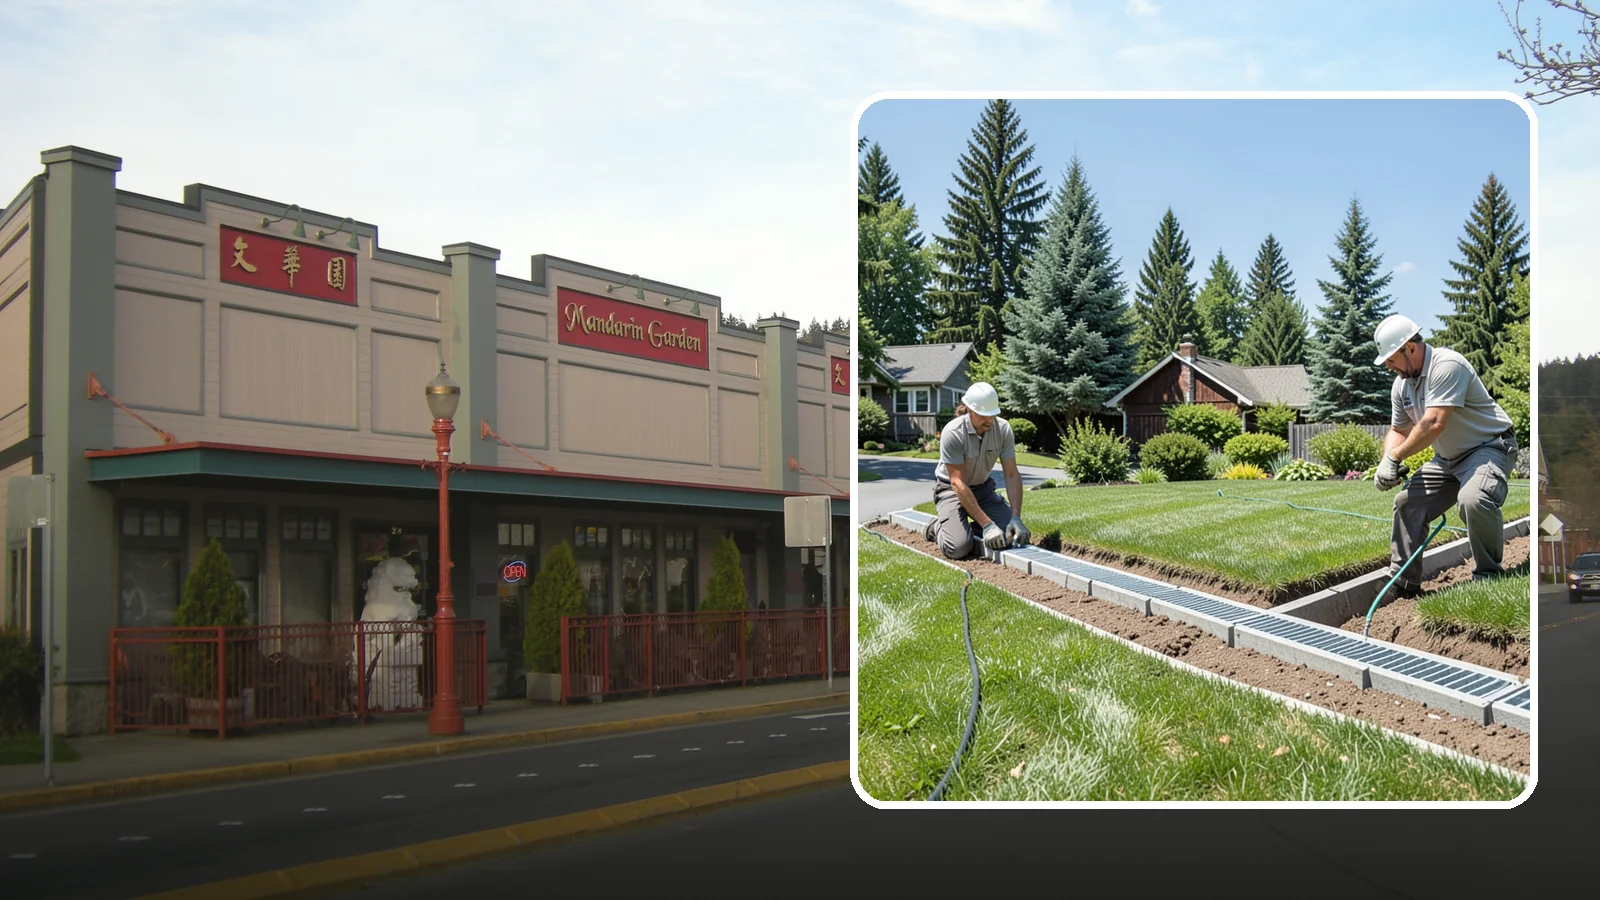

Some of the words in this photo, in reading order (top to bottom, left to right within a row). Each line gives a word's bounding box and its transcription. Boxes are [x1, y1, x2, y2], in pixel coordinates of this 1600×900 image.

[231, 236, 346, 291] 文華園
[564, 302, 644, 341] Mandarin
[648, 320, 702, 352] Garden
[503, 565, 527, 578] OPEN
